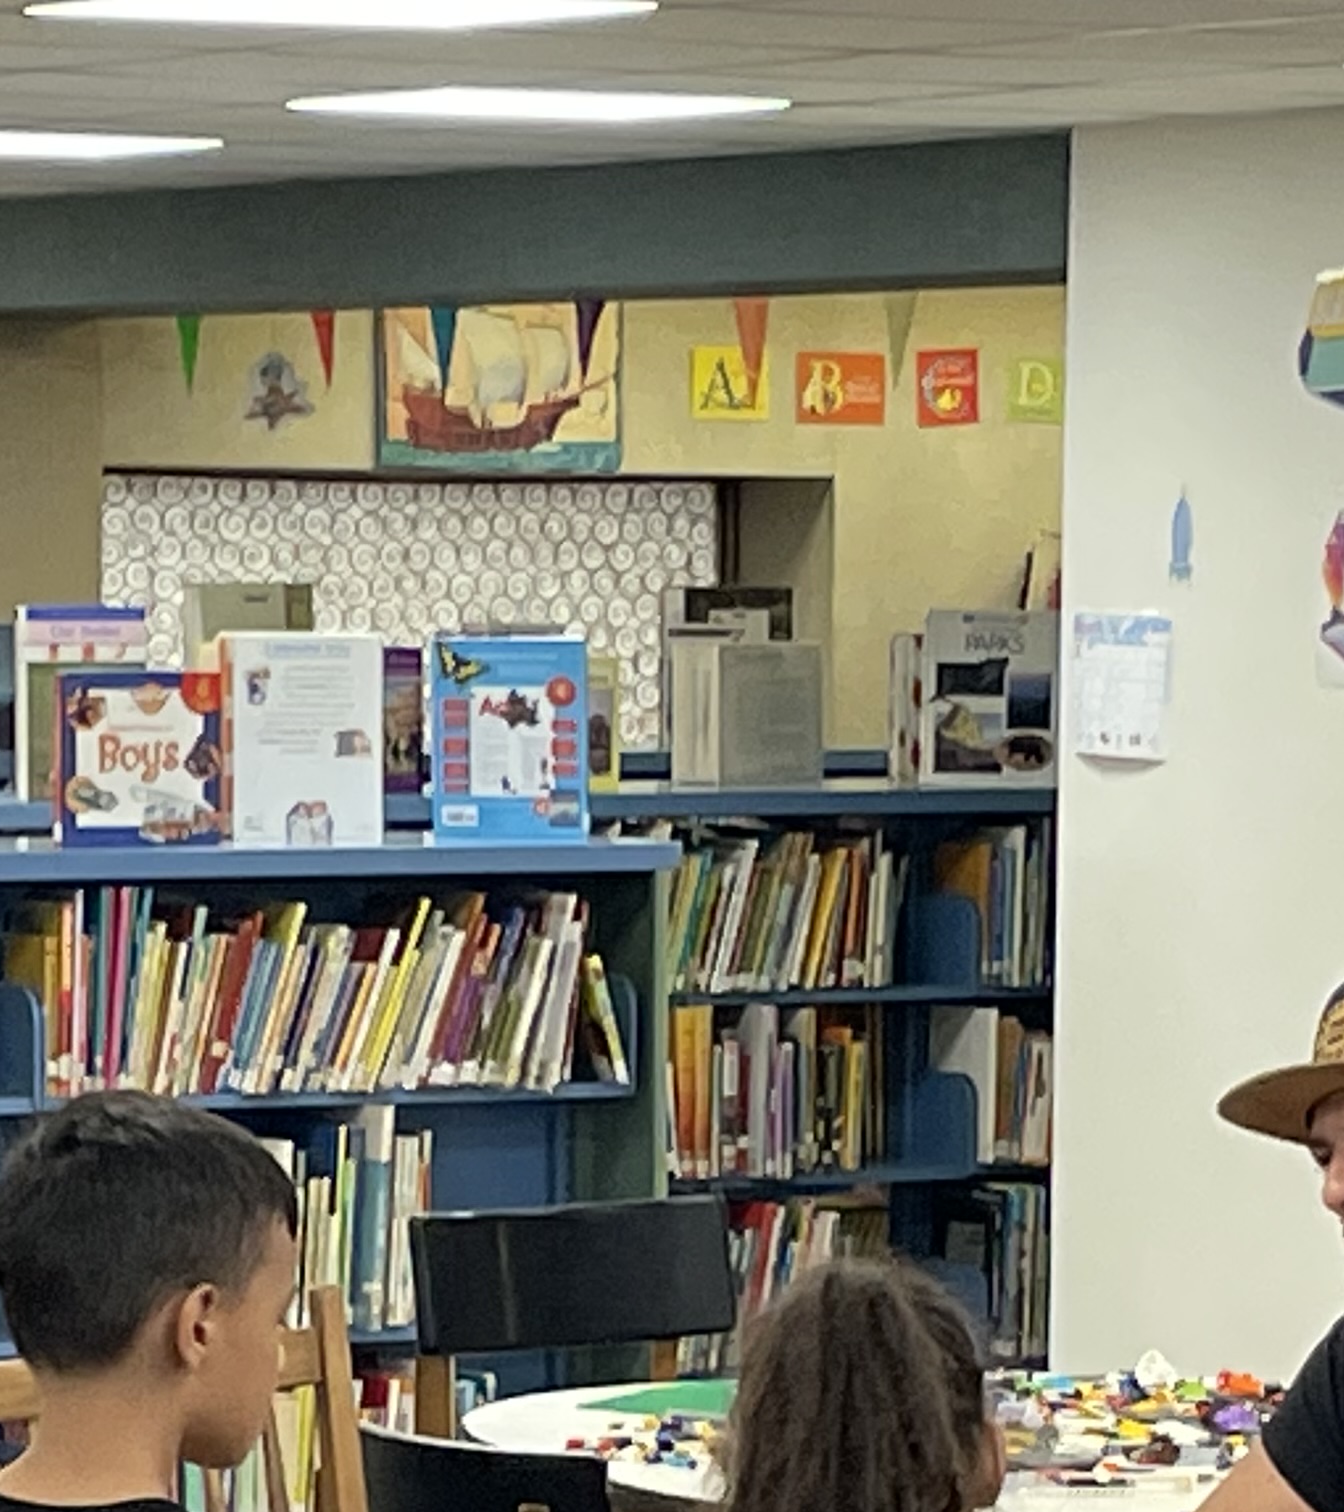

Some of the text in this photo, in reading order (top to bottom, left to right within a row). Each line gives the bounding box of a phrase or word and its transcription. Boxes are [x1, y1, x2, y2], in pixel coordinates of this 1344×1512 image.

[699, 356, 755, 410] A
[803, 359, 843, 415] B
[1016, 361, 1053, 405] D
[99, 732, 179, 783] Boys
